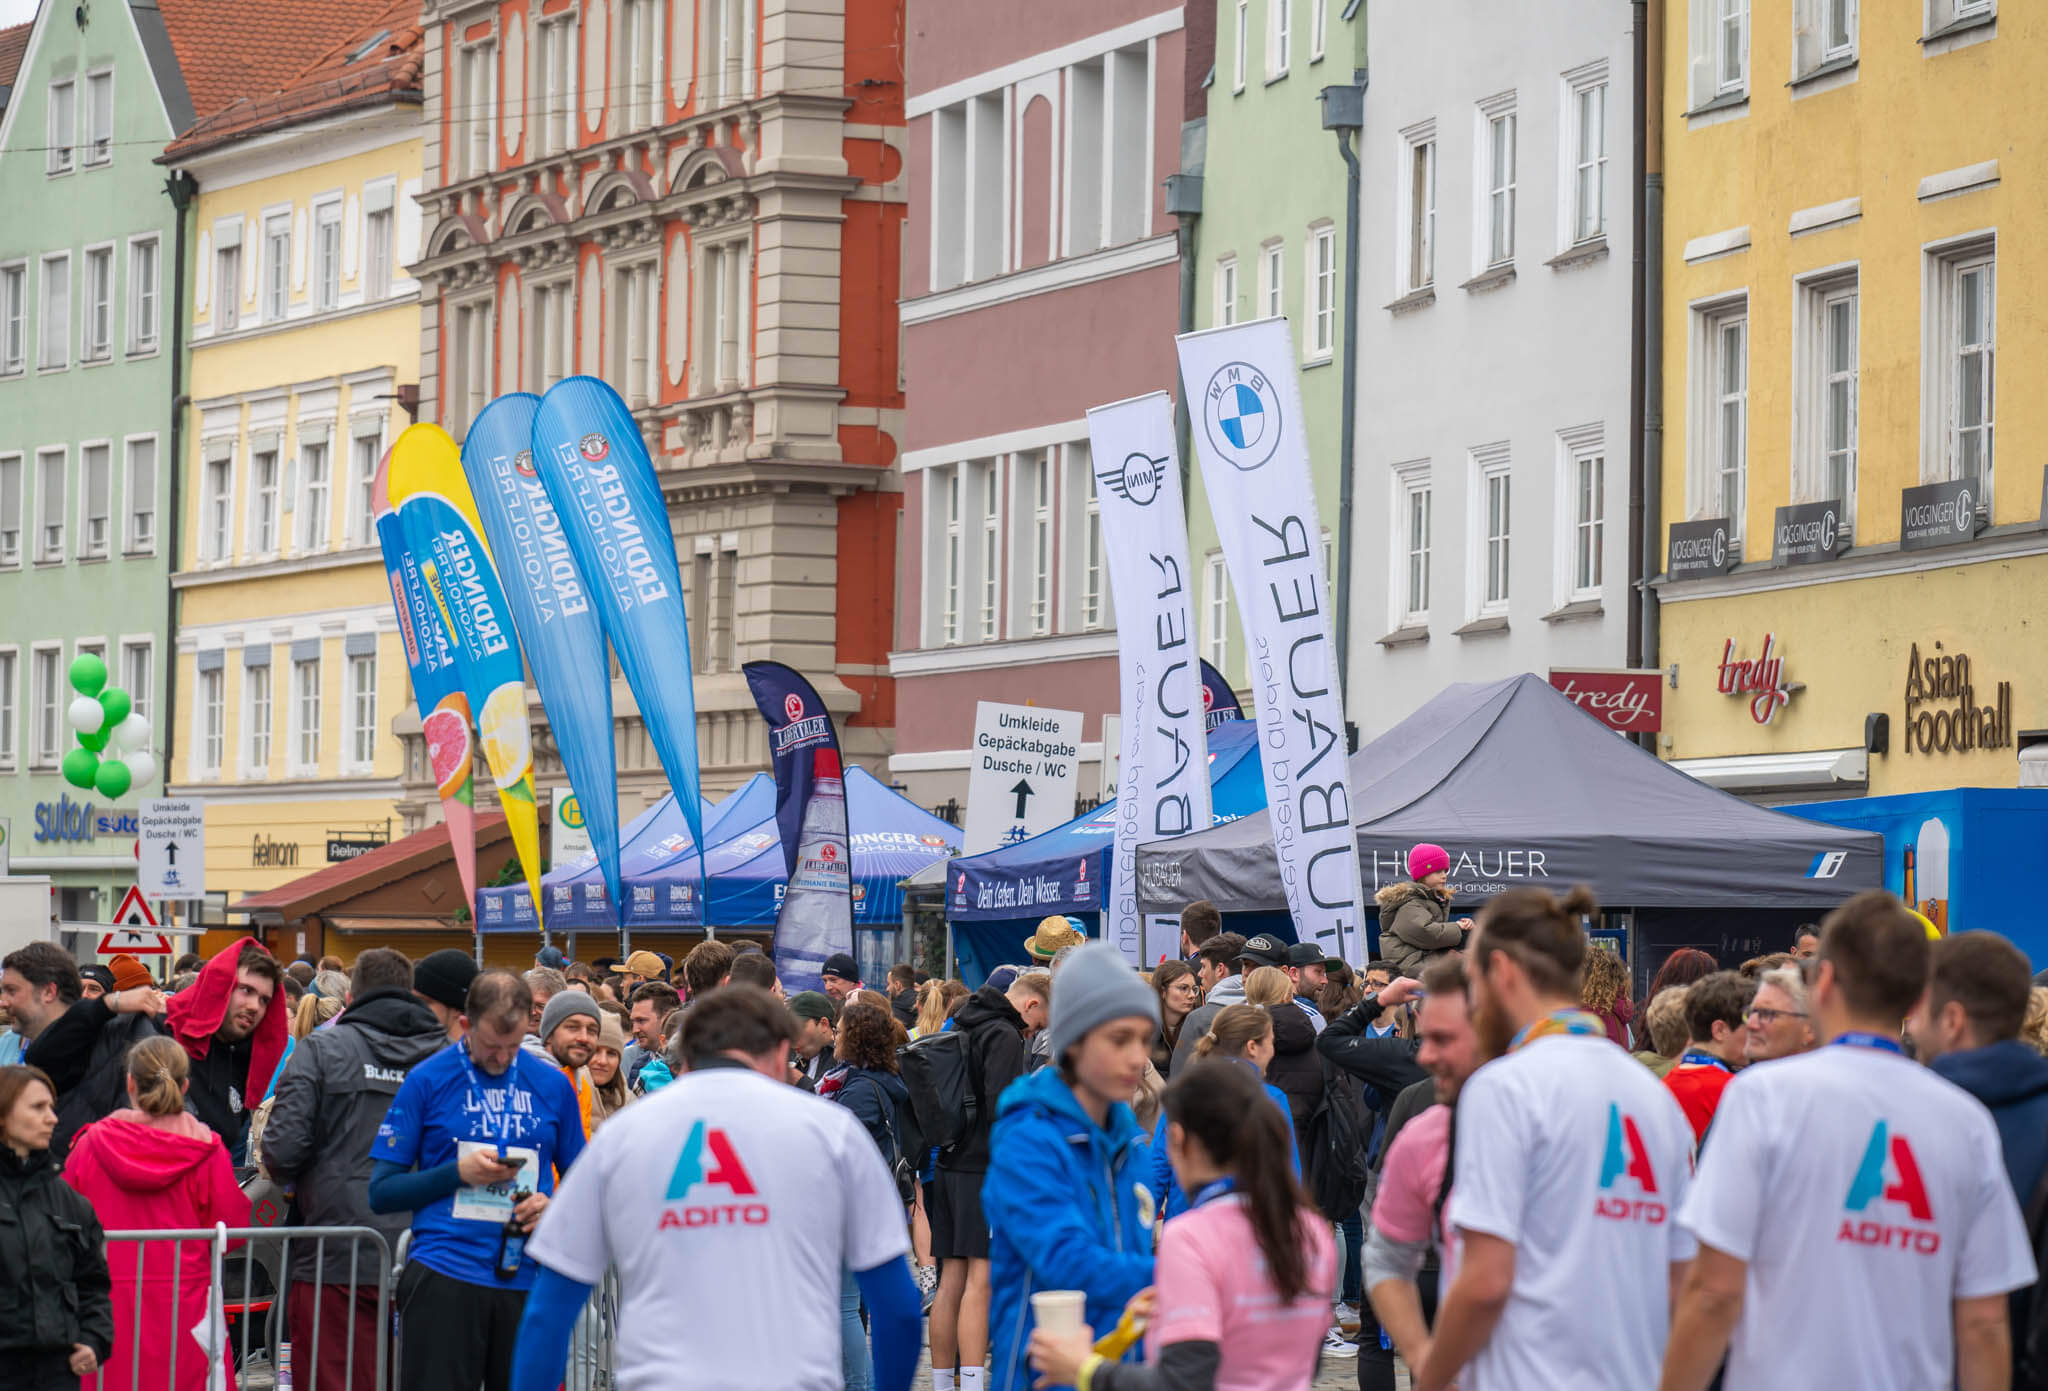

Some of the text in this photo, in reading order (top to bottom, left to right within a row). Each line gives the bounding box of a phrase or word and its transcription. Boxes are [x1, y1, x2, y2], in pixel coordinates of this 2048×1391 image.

[1905, 502, 1955, 527] VOGGINGER
[1778, 522, 1821, 545] VOGGINGER
[1671, 538, 1712, 560] VOGGINGER
[1717, 633, 1788, 725] tredy
[1905, 640, 1969, 699] Asian
[1561, 680, 1655, 725] tredy
[999, 713, 1060, 733] Umkleide
[1904, 681, 2011, 754] Foodhall
[978, 733, 1076, 758] Gepäckabgabe
[983, 756, 1067, 778] Dusche / WC
[153, 803, 190, 812] Umkleide
[97, 815, 139, 833] suto
[142, 815, 202, 826] Gepäckabgabe
[146, 829, 177, 838] Dusche
[184, 829, 198, 838] WC
[977, 881, 993, 909] Dein
[1017, 877, 1034, 906] Dein
[363, 1064, 405, 1083] BLACK
[657, 1204, 769, 1230] ADITO
[1837, 1220, 1941, 1255] ADITO
